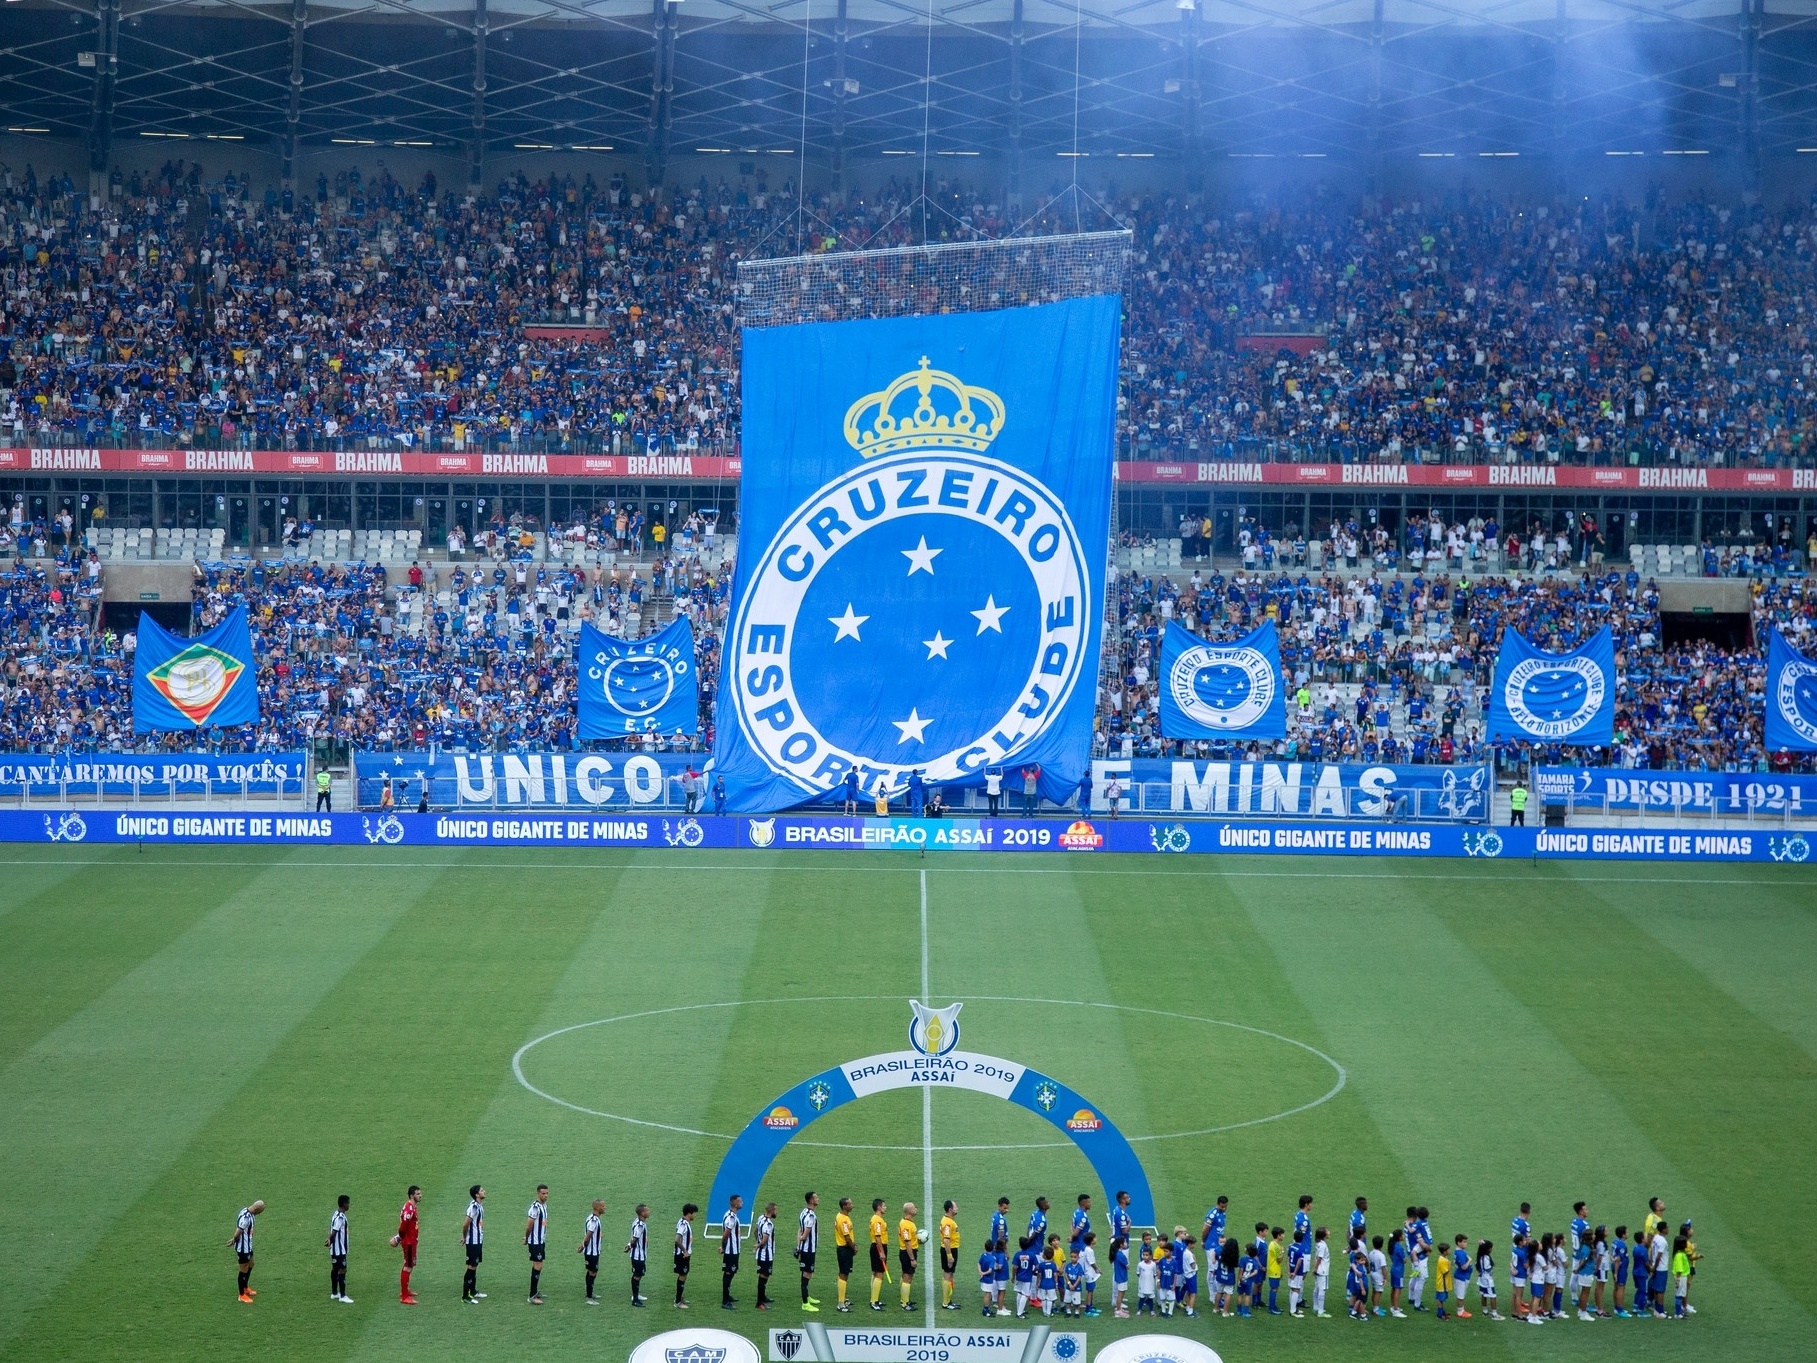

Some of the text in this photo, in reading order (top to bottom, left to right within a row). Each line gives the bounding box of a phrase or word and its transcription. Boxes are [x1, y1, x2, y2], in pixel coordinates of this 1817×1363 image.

[31, 450, 101, 469] BRAHMA
[142, 455, 169, 463] BRAHMA
[186, 451, 253, 470] BRAHMA
[293, 456, 319, 465] BRAHMA
[336, 453, 402, 471] BRAHMA
[441, 458, 467, 466] BRAHMA
[483, 455, 548, 473] BRAHMA
[586, 460, 612, 468] BRAHMA
[628, 457, 692, 475] BRAHMA
[1198, 463, 1262, 481] BRAHMA
[1343, 465, 1408, 483] BRAHMA
[1489, 466, 1556, 485] BRAHMA
[1639, 468, 1707, 487] BRAHMA
[777, 468, 1060, 582] CRUZEIRO
[0, 764, 154, 785] CANTAREMOS
[162, 764, 209, 784] POR
[217, 759, 287, 784] VOCÊS
[1171, 761, 1398, 817] MINAS
[1606, 778, 1801, 811] DESDE 1921
[117, 814, 332, 837] ÚNICO GIGANTE DE MINAS
[436, 817, 648, 840] ÚNICO GIGANTE DE MINAS
[786, 825, 927, 844] BRASILEIRÃO
[1002, 829, 1051, 845] 2019
[1219, 825, 1432, 850] ÚNICO GIGANTE DE MINAS
[1536, 830, 1752, 855] ÚNICO GIGANTE DE MINAS
[850, 1057, 1015, 1083] BRASILEIRÃO 2019
[844, 1333, 961, 1347] BRASILEIRÃO
[906, 1350, 949, 1362] 2019
